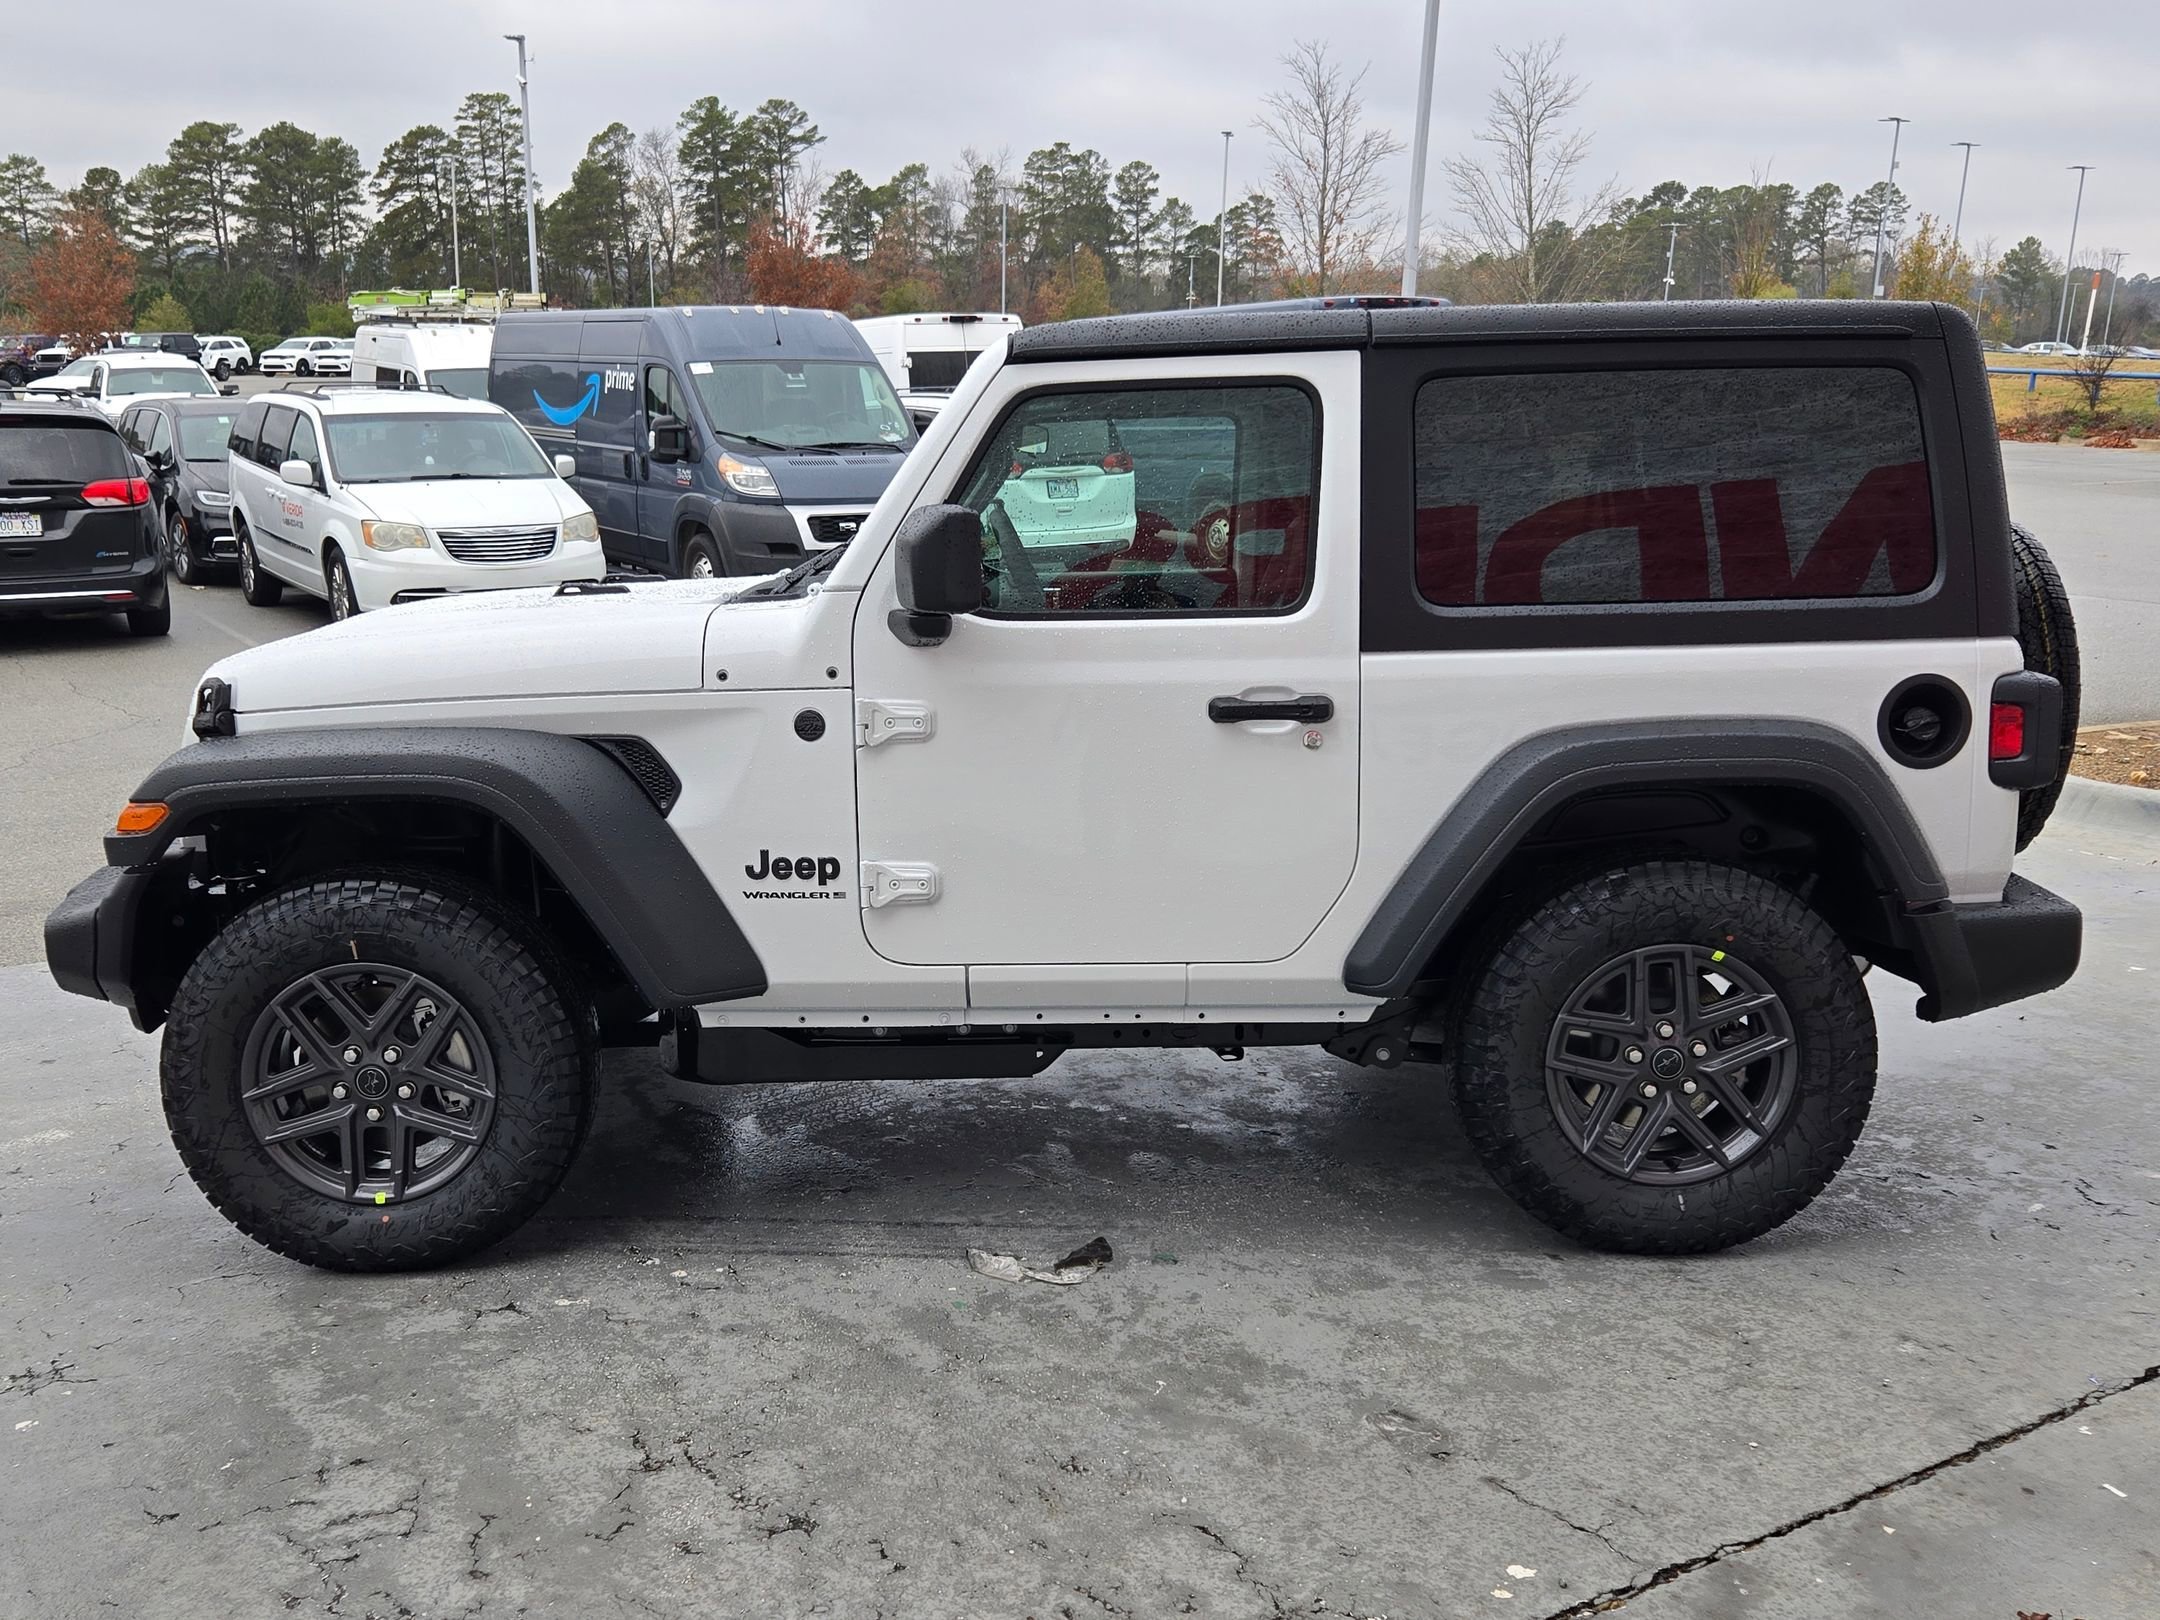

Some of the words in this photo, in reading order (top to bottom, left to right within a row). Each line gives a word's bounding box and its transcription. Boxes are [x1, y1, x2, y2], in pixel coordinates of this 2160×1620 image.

[604, 363, 635, 395] prime
[745, 849, 841, 886] Jeep
[742, 891, 831, 900] WRANGLER
